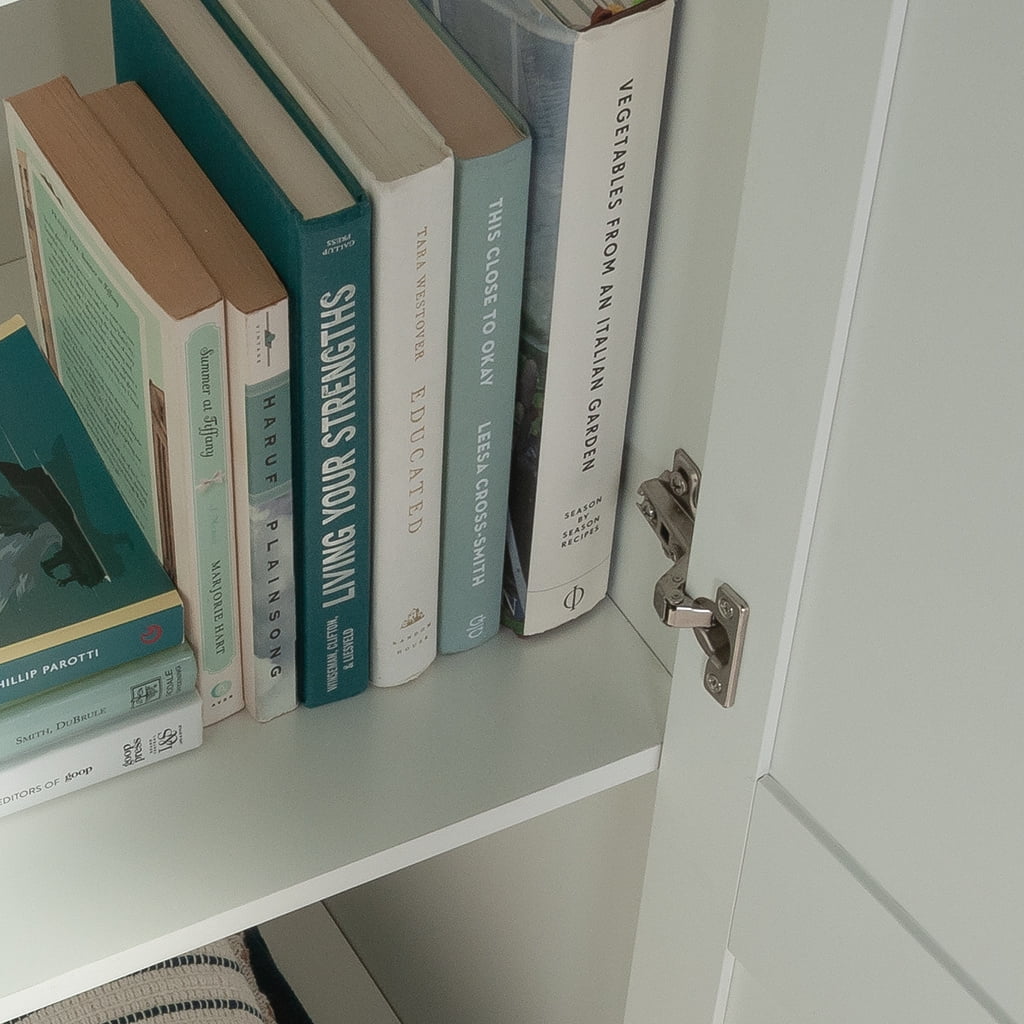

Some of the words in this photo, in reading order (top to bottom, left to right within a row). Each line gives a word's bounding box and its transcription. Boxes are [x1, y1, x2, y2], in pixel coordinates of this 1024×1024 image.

[608, 78, 633, 211] VEGETABLES
[487, 197, 503, 242] THIS
[322, 239, 356, 256] GALLUP
[416, 225, 427, 270] TARA
[602, 217, 621, 276] FROM
[483, 246, 501, 307] CLOSE
[598, 284, 614, 311] AN
[414, 273, 426, 362] WESTOVER
[482, 308, 497, 335] TO
[199, 346, 214, 396] Summer
[319, 283, 356, 449] STRENGTHS
[480, 339, 495, 386] OKAY
[590, 317, 611, 392] ITALIAN
[202, 399, 213, 413] at
[199, 415, 218, 459] Tiffany
[263, 394, 278, 484] HARUF
[408, 384, 426, 534] EDUCATED
[476, 420, 491, 474] LEESA
[581, 398, 602, 473] GARDEN
[321, 447, 356, 526] YOUR
[563, 496, 603, 520] SEASON
[471, 478, 489, 587] CROSS-SMITH
[560, 525, 600, 549] RECIPES
[562, 515, 601, 540] SEASON
[577, 512, 590, 524] BY
[321, 523, 356, 609] LIVING
[209, 559, 224, 623] MARJORIE
[266, 519, 282, 678] PLAINSONG
[42, 648, 100, 675] PAROTTI
[214, 623, 226, 656] HART
[44, 778, 60, 790] OF
[64, 765, 94, 782] goop
[122, 743, 135, 768] goop
